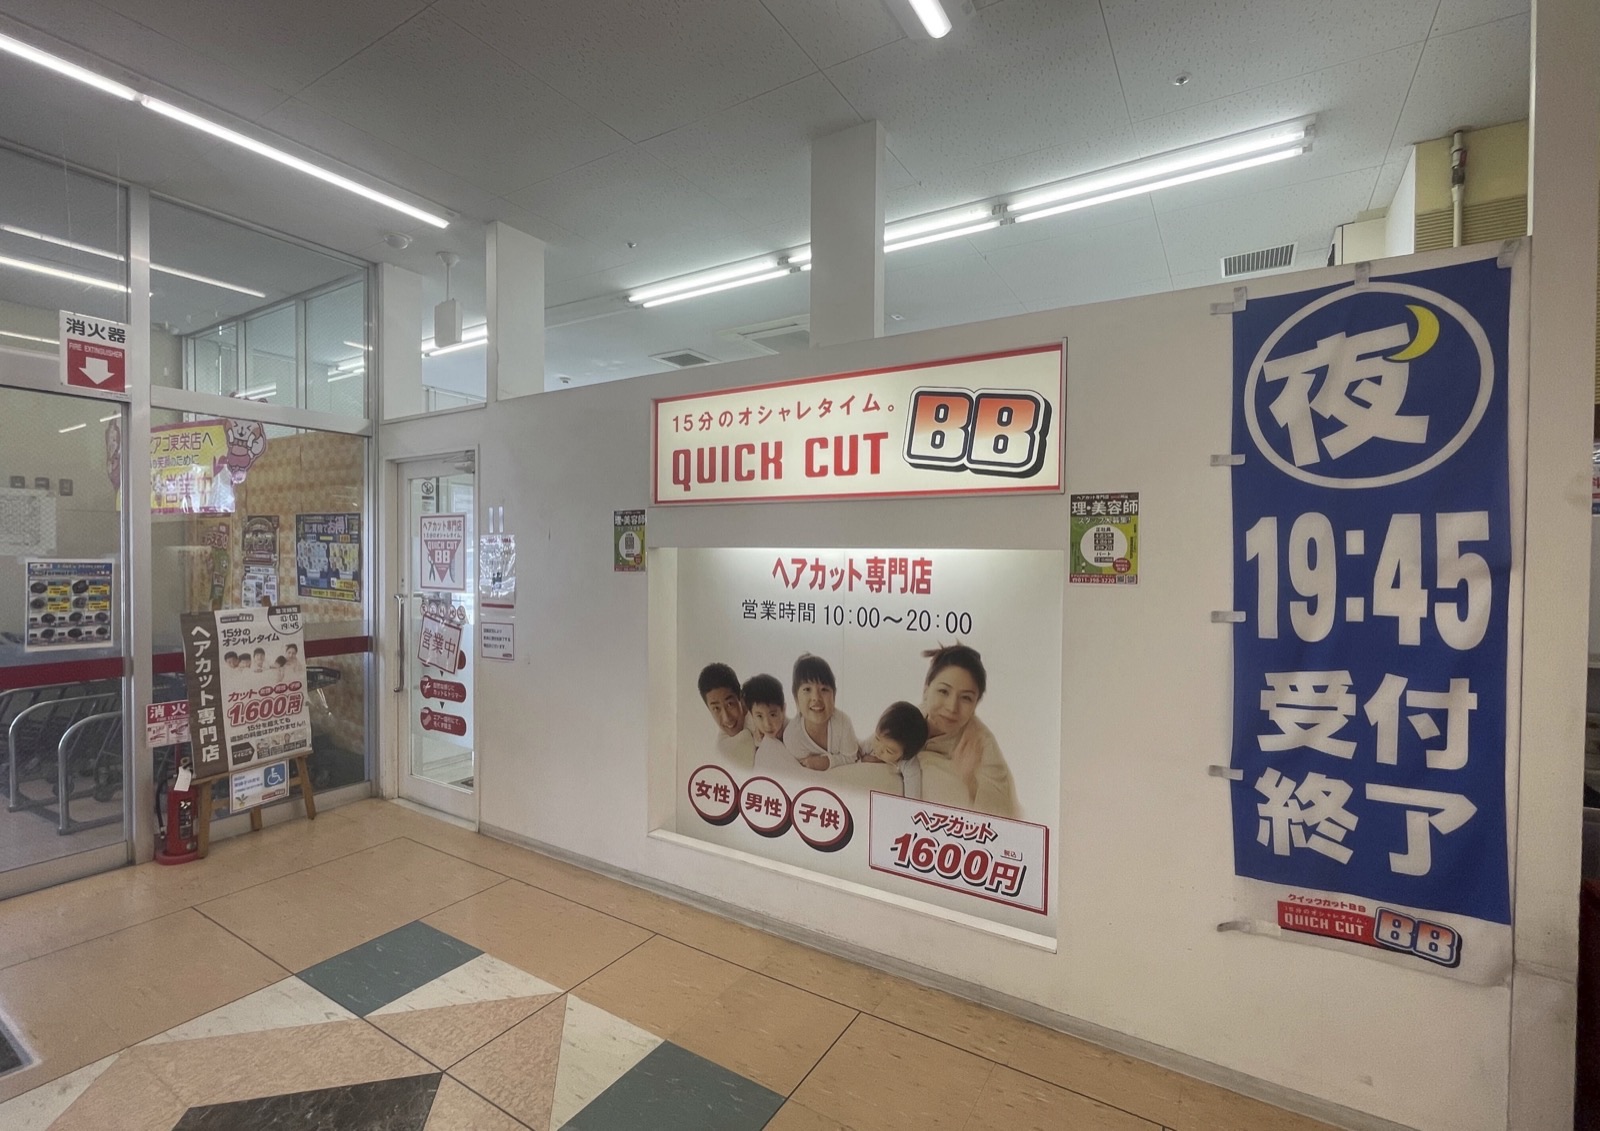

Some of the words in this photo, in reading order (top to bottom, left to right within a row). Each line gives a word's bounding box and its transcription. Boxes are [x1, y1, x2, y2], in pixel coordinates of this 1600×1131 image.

[66, 317, 126, 343] 消火器
[1262, 322, 1430, 467] 夜
[672, 393, 895, 433] 15分のオシャレタイム。
[672, 440, 783, 491] QUICK
[805, 432, 888, 478] CUT
[1071, 500, 1138, 515] 理・美容師
[772, 556, 933, 595] ヘアカット専門店
[1245, 511, 1492, 651] 19:45
[742, 599, 816, 625] 営業時間
[221, 628, 251, 638] 15分の
[222, 633, 280, 647] オシャレタイム
[422, 628, 456, 659] 営業中
[191, 625, 220, 763] ヘアカット専門店
[228, 689, 257, 703] カット
[1257, 670, 1478, 770] 受付
[695, 780, 731, 804] 女性
[745, 793, 782, 818] 男性
[798, 803, 840, 831] 子供
[912, 810, 997, 844] ヘアカット
[1254, 767, 1478, 876] 終了
[893, 833, 1022, 893] 1600円
[1284, 912, 1329, 930] QUICK
[1335, 920, 1364, 936] CUT
